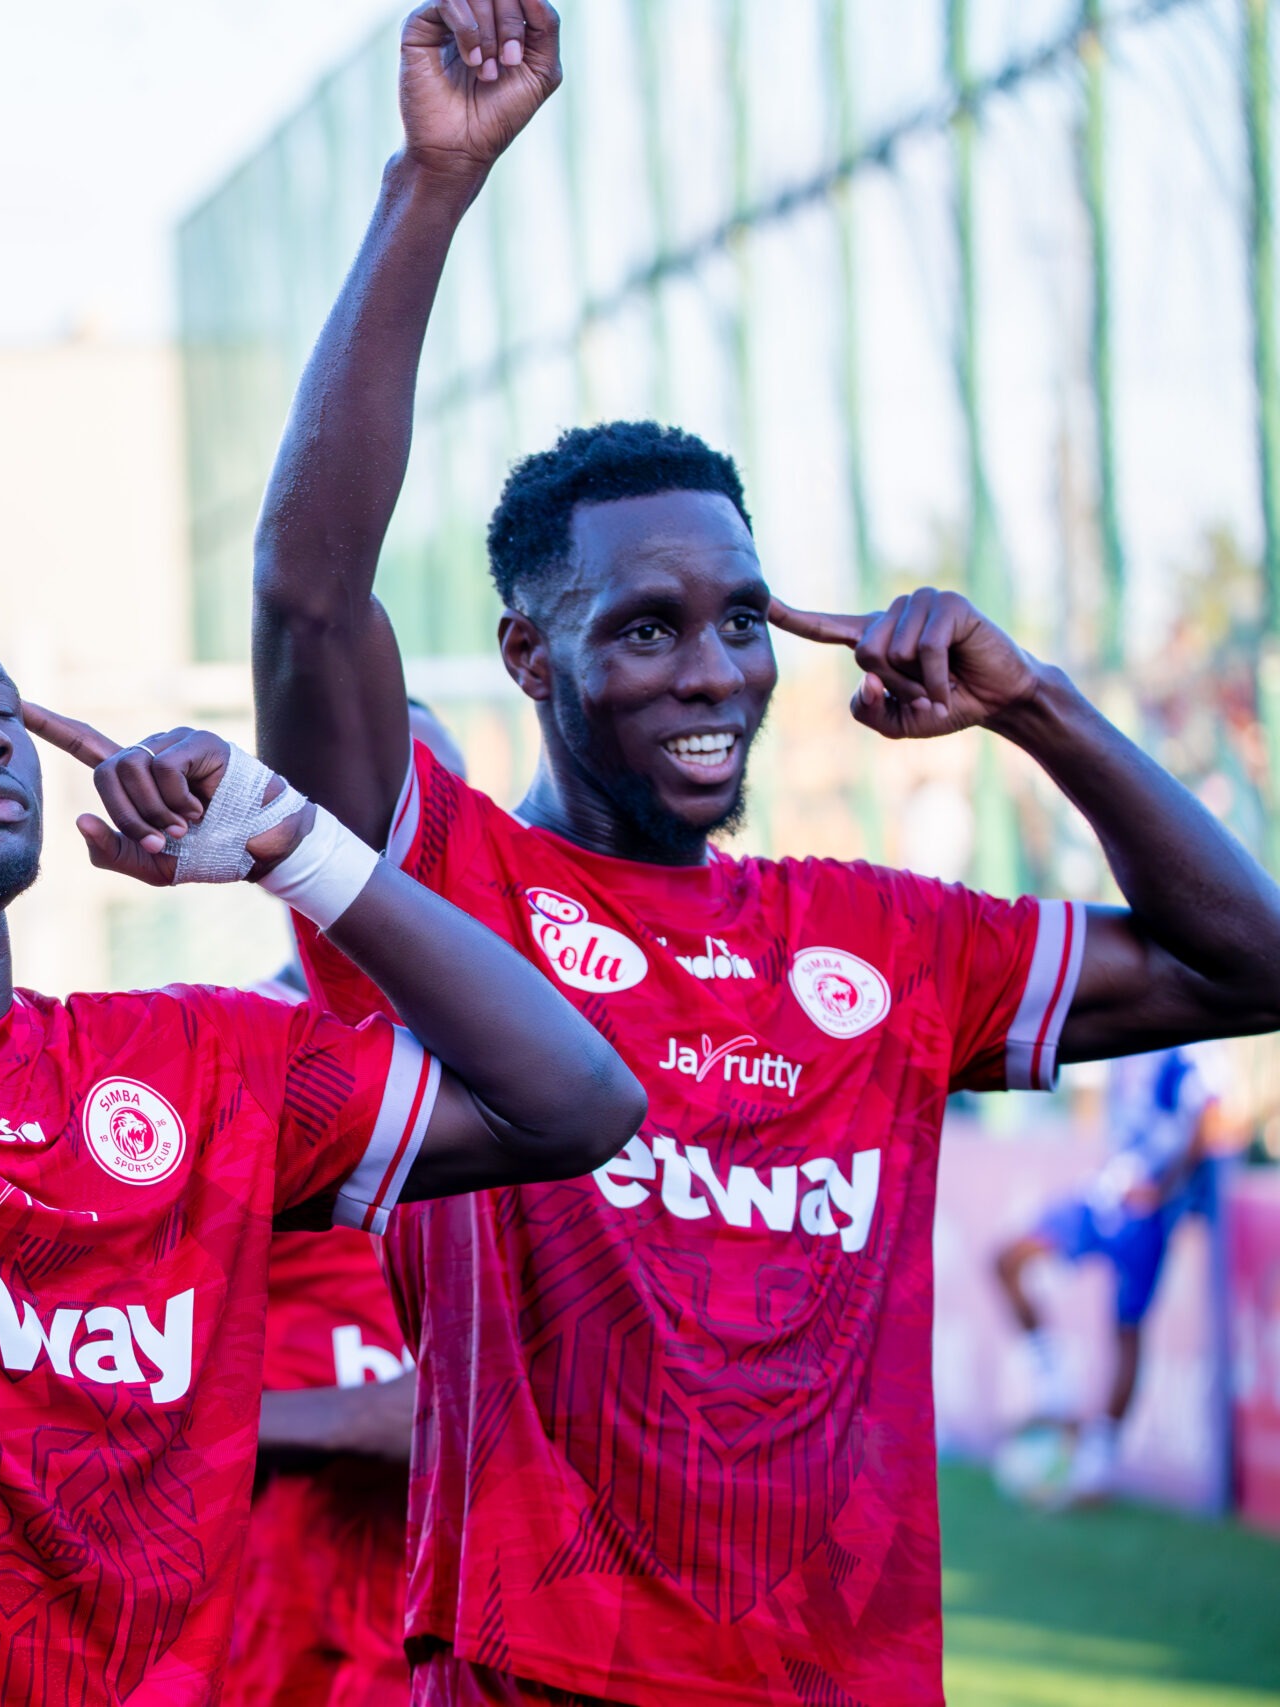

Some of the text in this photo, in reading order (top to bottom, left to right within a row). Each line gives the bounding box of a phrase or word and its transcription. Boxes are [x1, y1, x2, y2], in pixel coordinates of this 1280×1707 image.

[540, 923, 627, 983] Cola
[99, 1089, 141, 1112] SIMBA
[155, 1118, 167, 1129] 36
[99, 1134, 109, 1143] 19
[114, 1141, 172, 1173] SPORTS CLUB
[592, 1133, 880, 1253] etway
